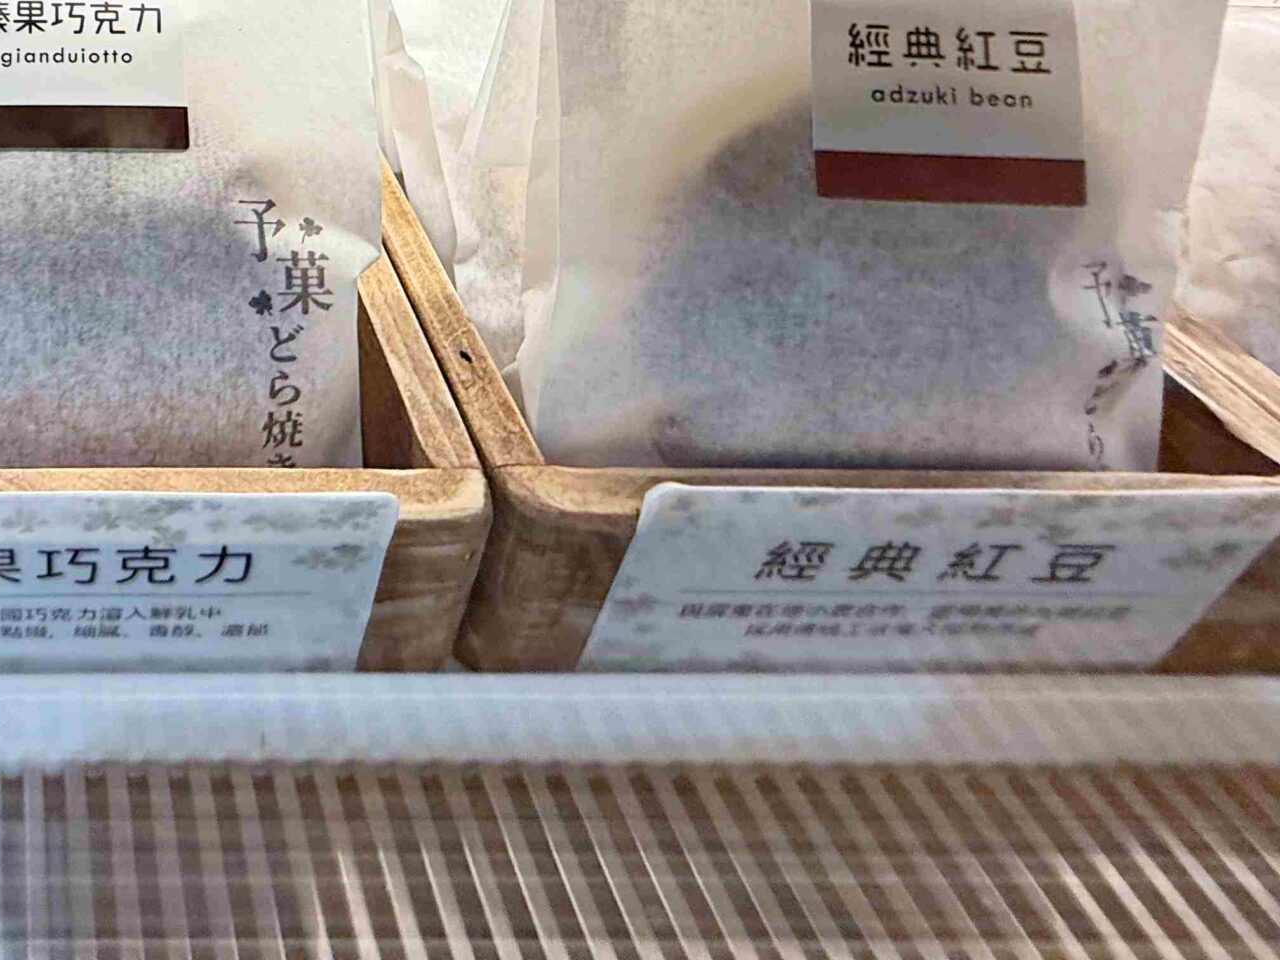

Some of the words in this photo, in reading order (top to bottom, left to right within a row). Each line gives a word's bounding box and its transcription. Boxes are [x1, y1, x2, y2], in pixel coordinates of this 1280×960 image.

[0, 47, 134, 67] gianduiotto
[846, 22, 1052, 76] 經典紅豆
[870, 83, 958, 107] adzuki
[969, 85, 1034, 109] bean
[753, 540, 1117, 582] 經典紅豆
